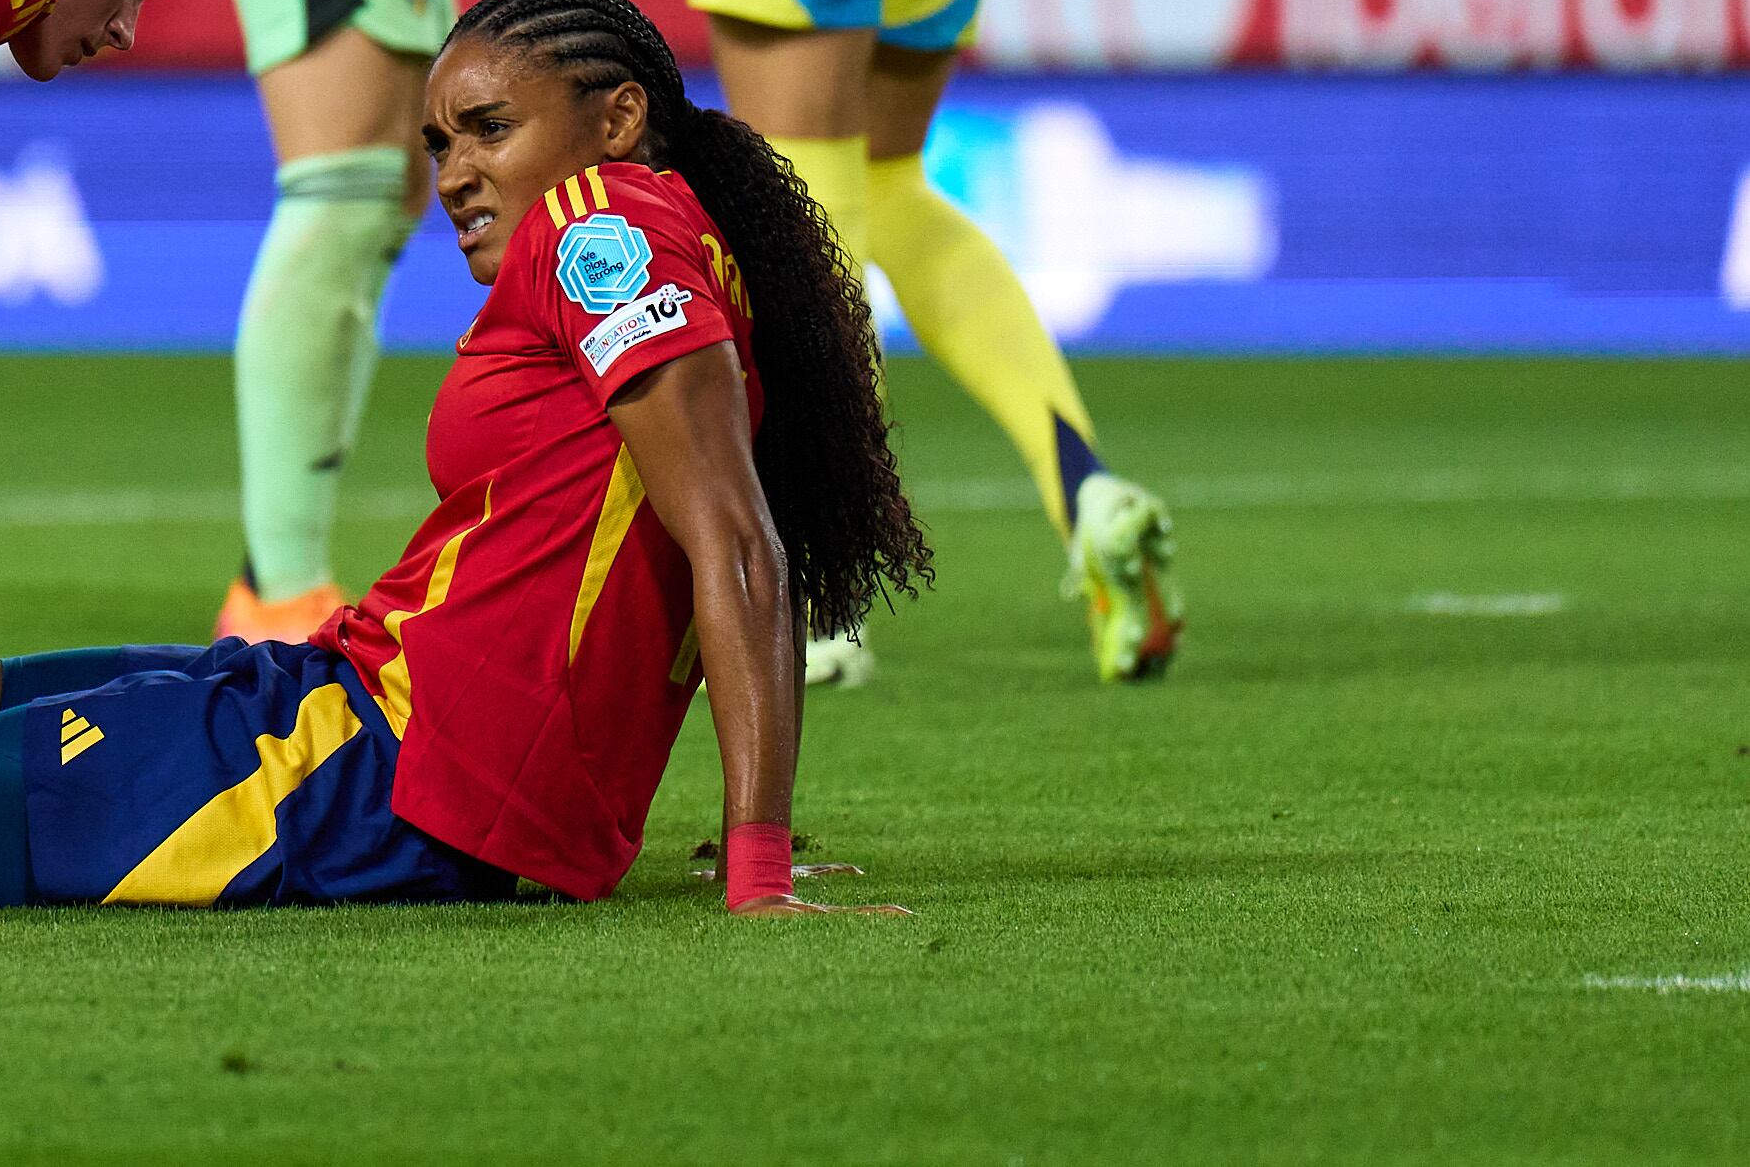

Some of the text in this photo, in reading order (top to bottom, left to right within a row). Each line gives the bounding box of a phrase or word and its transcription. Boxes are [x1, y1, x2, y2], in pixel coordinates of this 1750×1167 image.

[579, 251, 596, 262] We
[588, 261, 624, 283] Strong
[645, 297, 678, 324] 10
